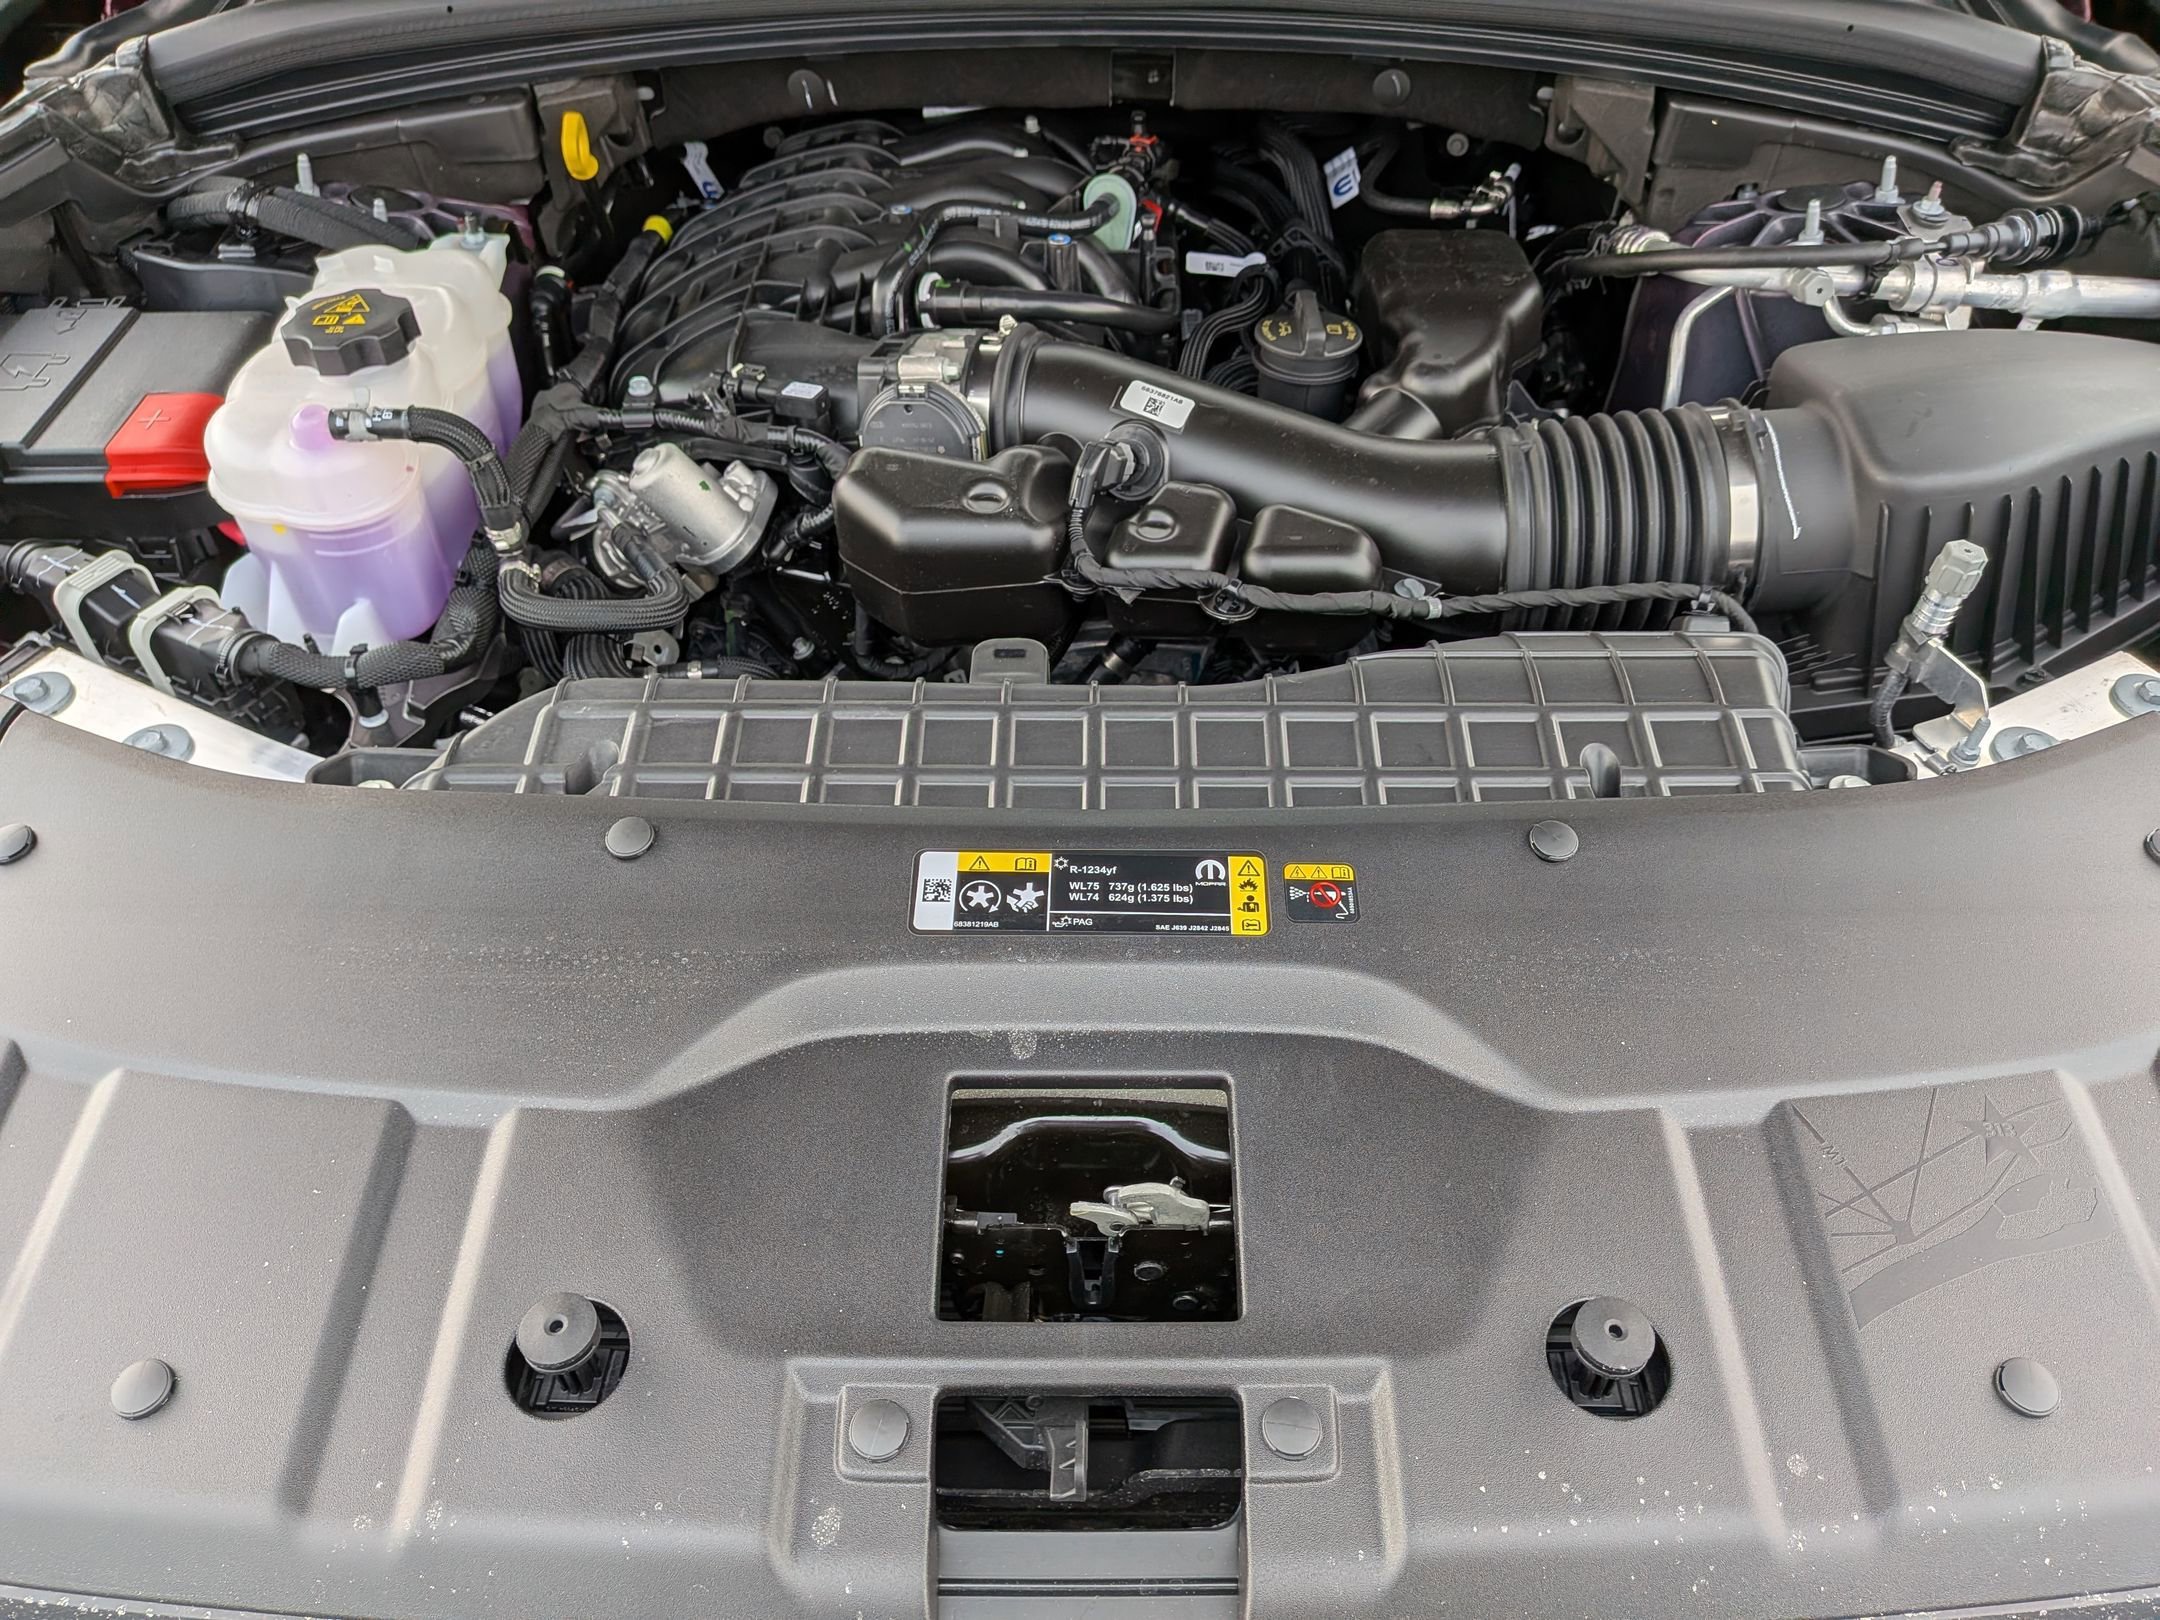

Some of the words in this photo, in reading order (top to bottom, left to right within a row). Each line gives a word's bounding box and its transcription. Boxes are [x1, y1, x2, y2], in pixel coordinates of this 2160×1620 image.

[1069, 866, 1117, 876] R-1234yf
[1069, 881, 1100, 890] WL75
[1108, 882, 1135, 893] 737g
[1137, 882, 1170, 893] (1.625
[1173, 883, 1194, 893] lbs)
[1069, 893, 1100, 901] WL74
[1108, 893, 1135, 904] 624g
[1137, 893, 1170, 904] (1.375
[1173, 894, 1194, 905] lbs)
[1072, 918, 1093, 926] PAG
